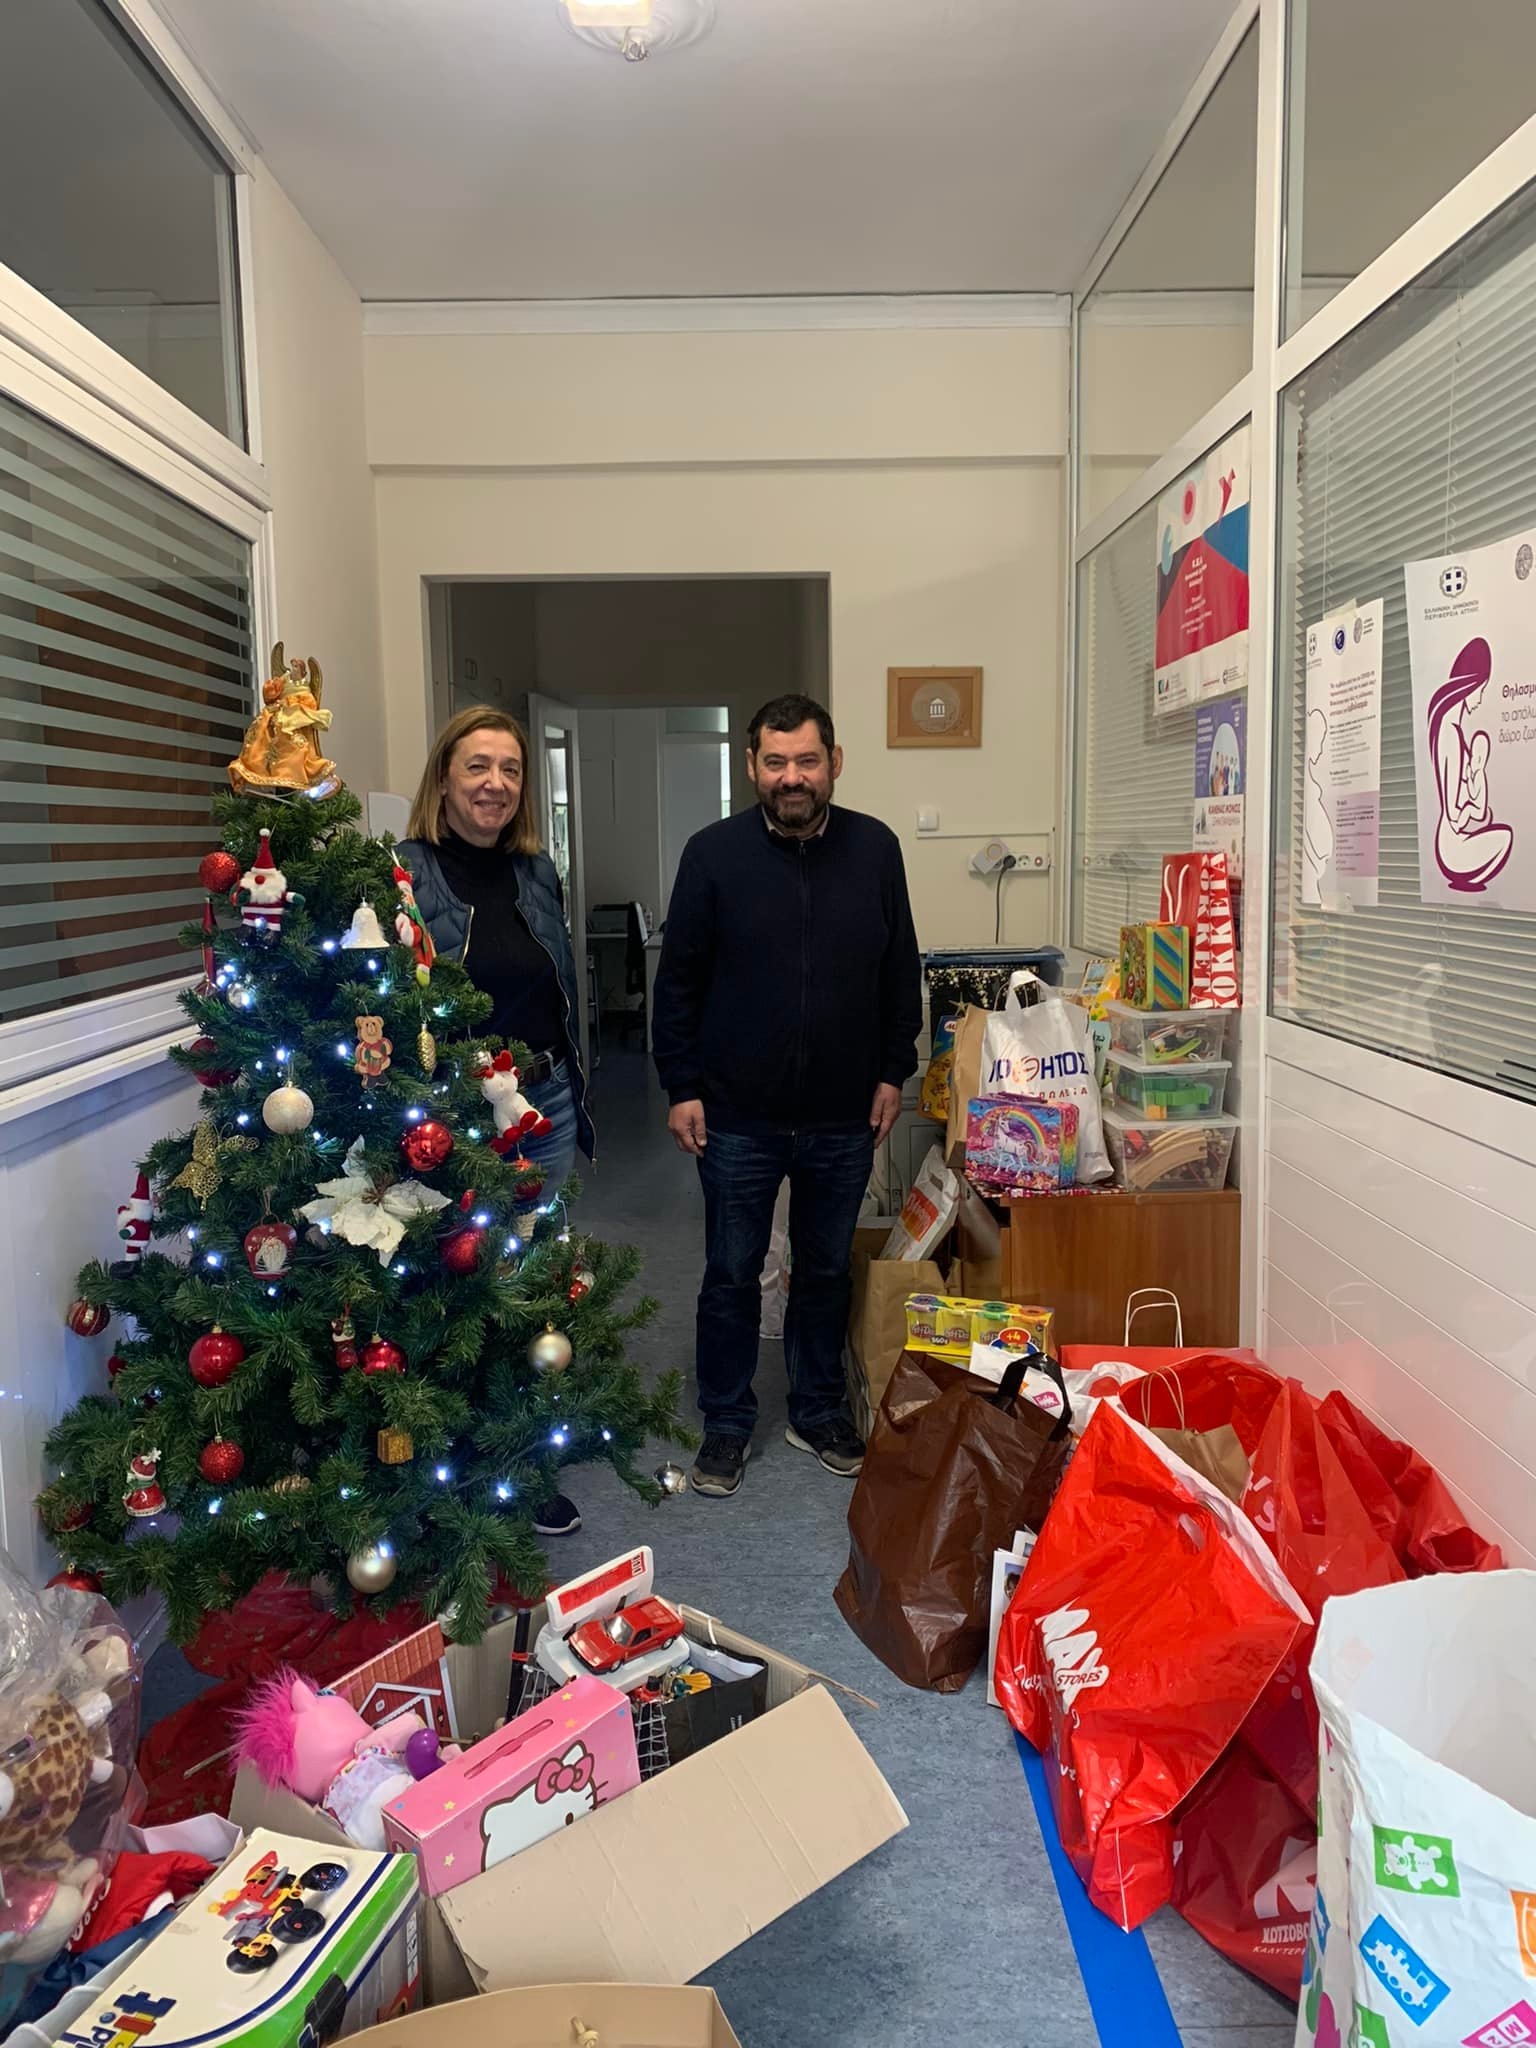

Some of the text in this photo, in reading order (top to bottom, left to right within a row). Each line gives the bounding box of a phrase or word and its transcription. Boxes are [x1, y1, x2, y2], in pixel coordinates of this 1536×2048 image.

[1502, 683, 1536, 701] Θηλασμ
[1501, 705, 1536, 722] το απόλυ
[1499, 725, 1536, 744] δώρο ζω
[1056, 1670, 1103, 1687] STORES
